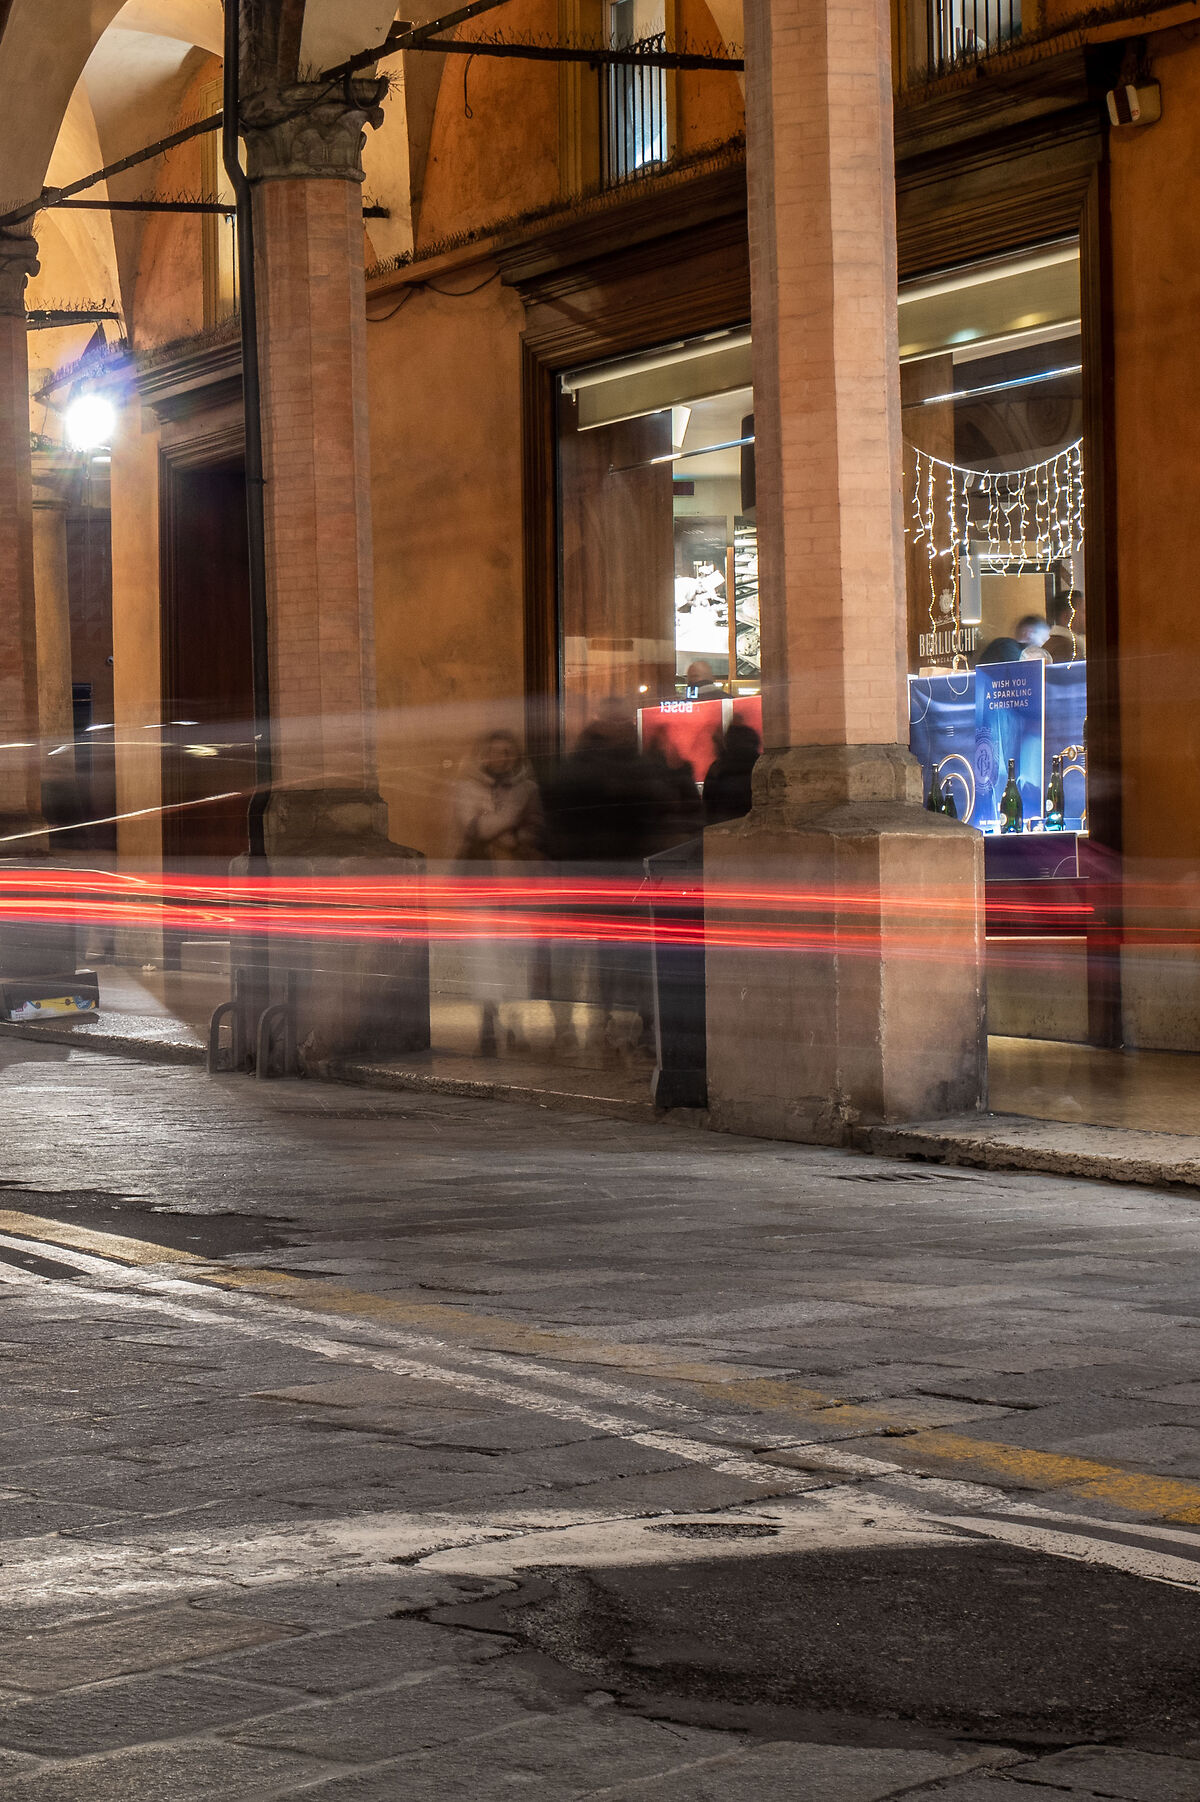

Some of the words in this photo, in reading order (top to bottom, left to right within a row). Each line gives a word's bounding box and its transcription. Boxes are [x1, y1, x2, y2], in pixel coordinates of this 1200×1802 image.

[919, 627, 975, 657] BERLUCCHI
[991, 680, 1010, 689] WISH
[1012, 678, 1027, 686] YOU
[986, 692, 991, 700] A
[993, 688, 1032, 699] SPARKLING
[989, 699, 1029, 710] CHRISTMAS
